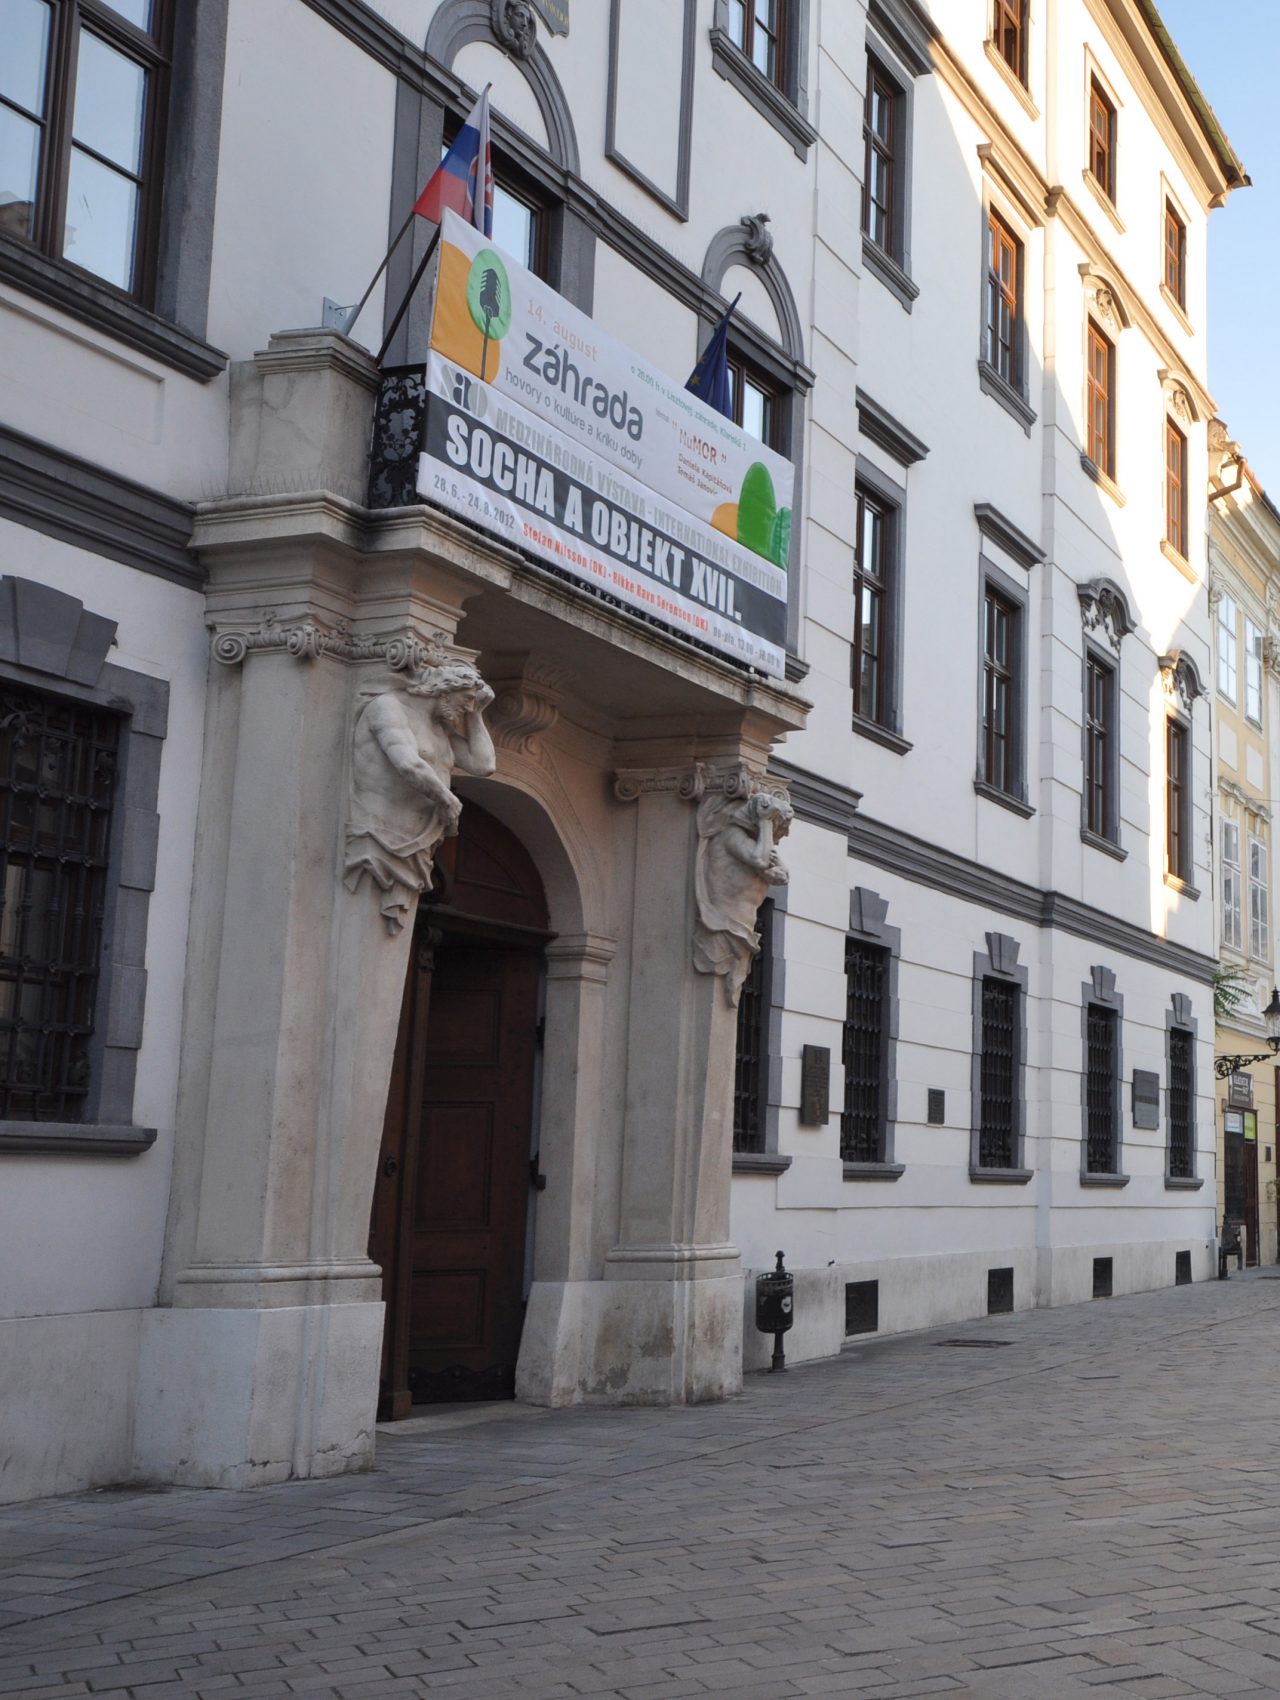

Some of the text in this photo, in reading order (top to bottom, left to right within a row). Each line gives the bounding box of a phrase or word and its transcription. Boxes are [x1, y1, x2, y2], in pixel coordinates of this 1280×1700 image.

[528, 299, 598, 362] 14. august
[505, 367, 542, 400] hovory
[544, 395, 551, 408] o
[554, 399, 586, 431] kultúre
[587, 422, 594, 436] a
[620, 445, 643, 470] doby
[522, 331, 643, 442] záhrada
[446, 414, 743, 624] SOCHA A OBJEKT XVII.
[494, 407, 595, 487] MEDZINÁRODNÁ
[597, 470, 646, 518] VÝSTAVA
[653, 506, 732, 568] INTERNATIONAL
[732, 552, 783, 598] EXHIBITION
[522, 522, 551, 549] Stefan
[554, 538, 588, 569] Nilsson
